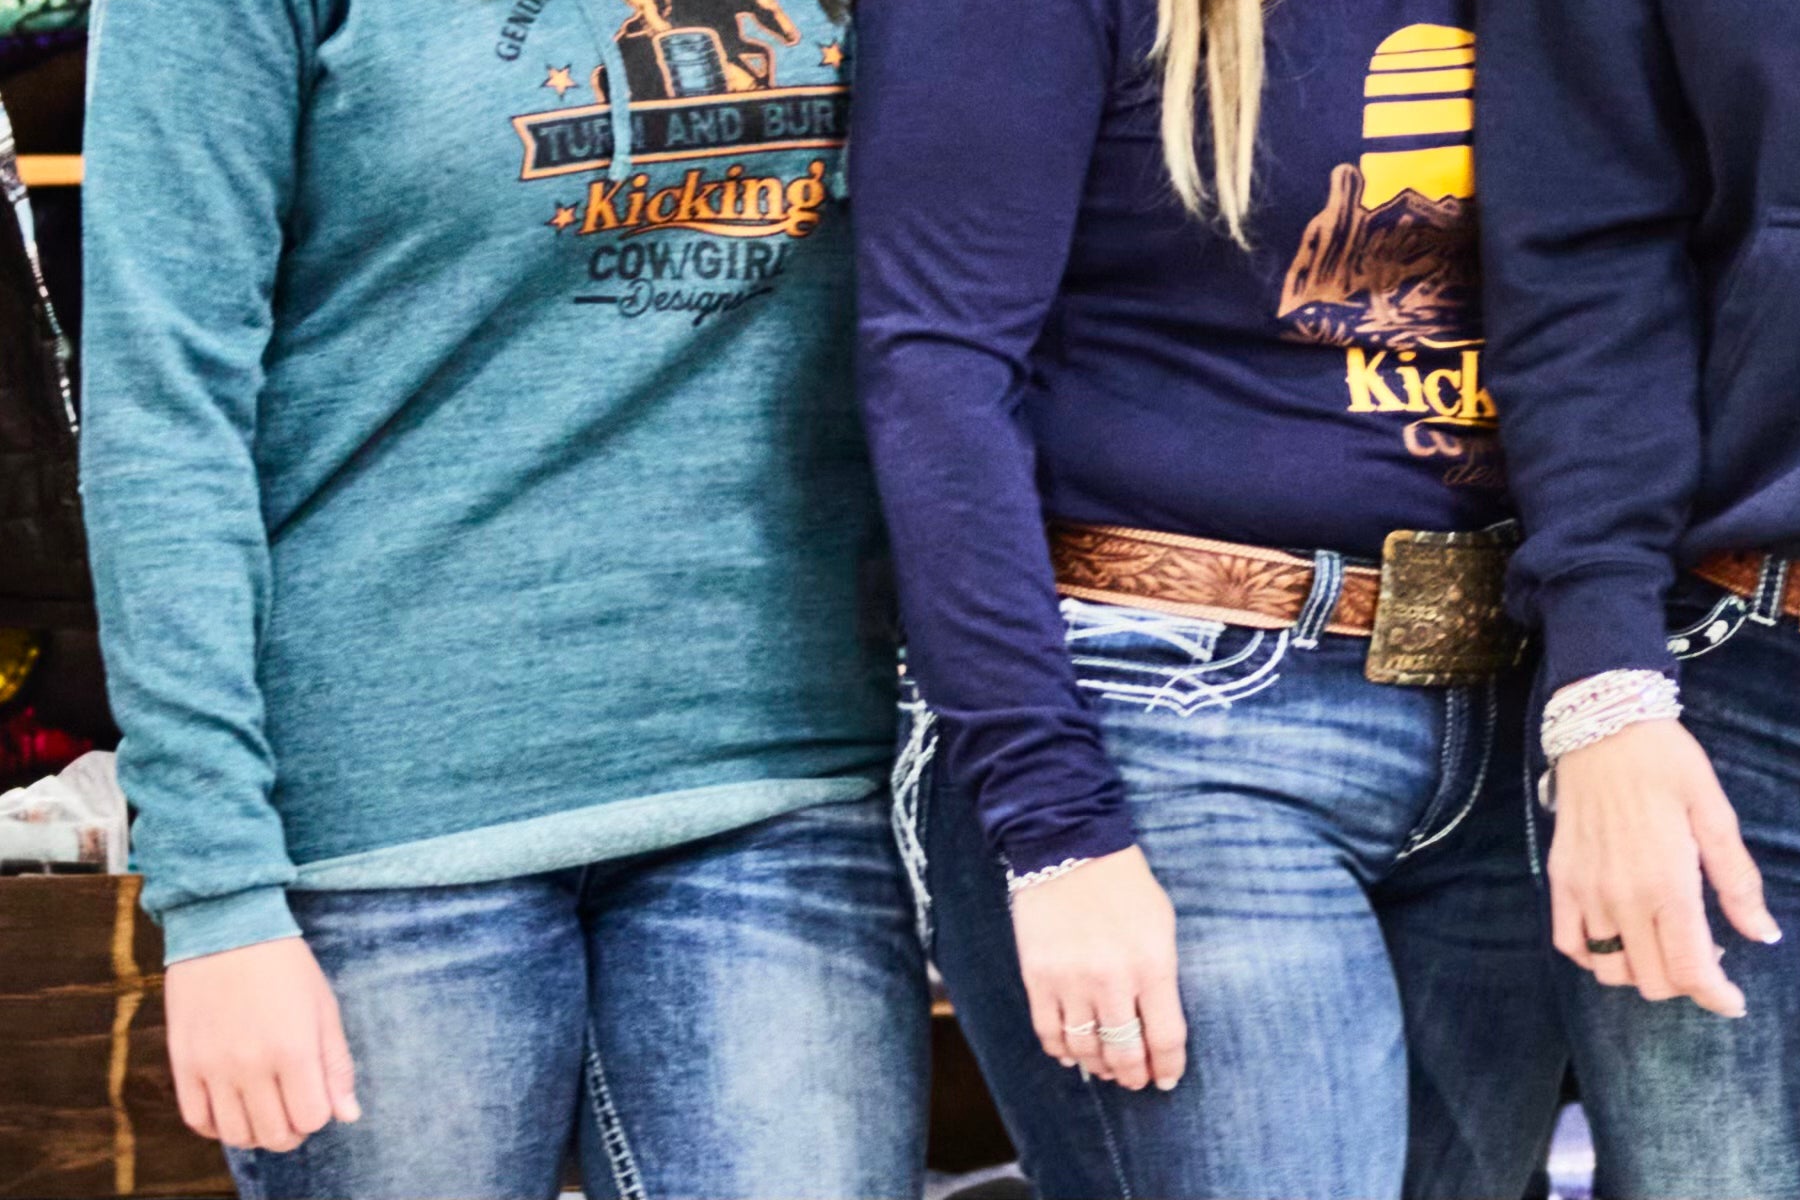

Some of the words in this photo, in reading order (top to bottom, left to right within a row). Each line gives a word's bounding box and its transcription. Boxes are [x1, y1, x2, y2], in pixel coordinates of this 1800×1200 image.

[666, 106, 741, 146] AND
[762, 97, 835, 138] BUR
[577, 159, 827, 239] Kicking
[1346, 347, 1498, 420] Kick
